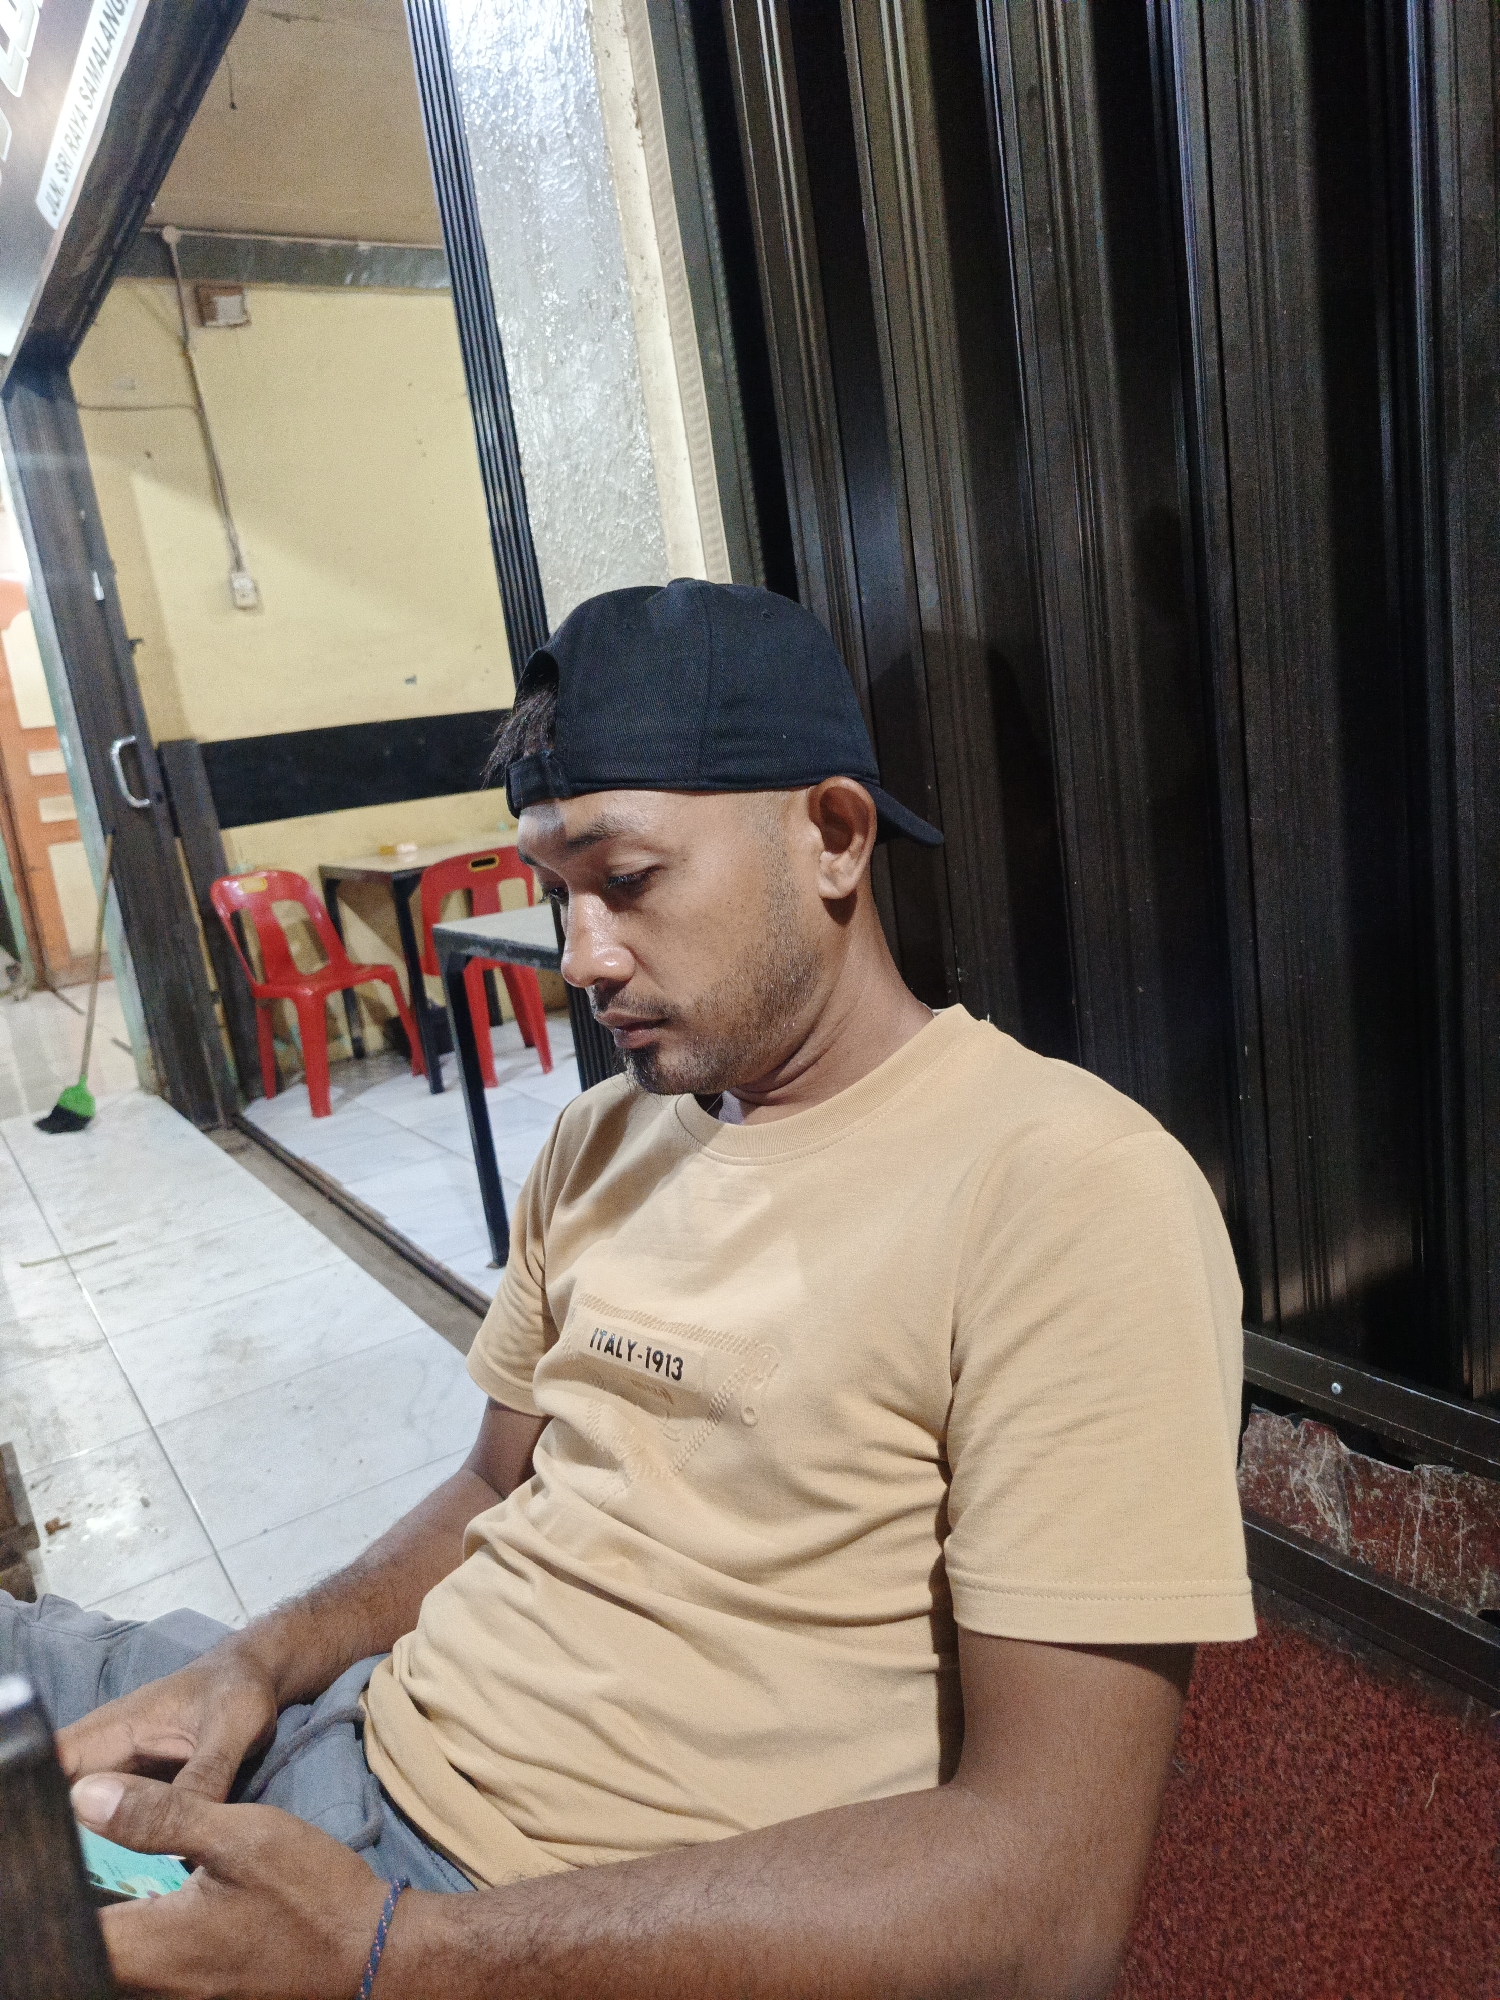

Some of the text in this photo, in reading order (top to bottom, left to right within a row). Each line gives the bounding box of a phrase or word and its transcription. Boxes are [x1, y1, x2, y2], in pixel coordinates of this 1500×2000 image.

[79, 0, 129, 109] SAMALANG
[64, 104, 90, 157] RAYA
[55, 146, 75, 183] SRI
[589, 1327, 684, 1381] ITALY-1913
